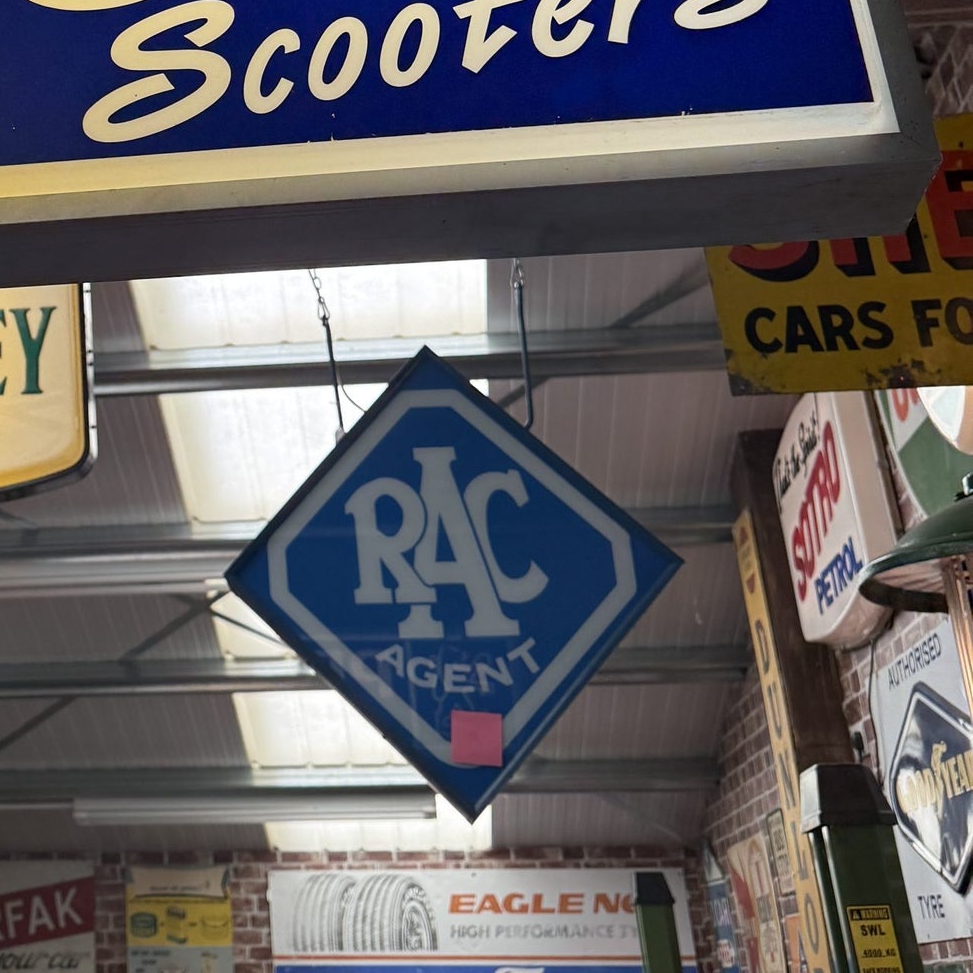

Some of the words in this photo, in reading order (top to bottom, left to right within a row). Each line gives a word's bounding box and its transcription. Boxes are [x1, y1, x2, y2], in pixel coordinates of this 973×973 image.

[744, 300, 895, 354] CARS
[344, 446, 550, 639] RAC
[813, 535, 864, 616] PETROL
[375, 636, 541, 695] AGENT
[887, 632, 942, 690] AUTHORISED
[754, 618, 826, 973] DUNLO
[448, 892, 584, 915] EAGLE
[450, 924, 490, 938] HIGH
[495, 923, 614, 938] PERFORMANCE
[860, 923, 886, 937] SWL
[917, 893, 946, 919] TYRE
